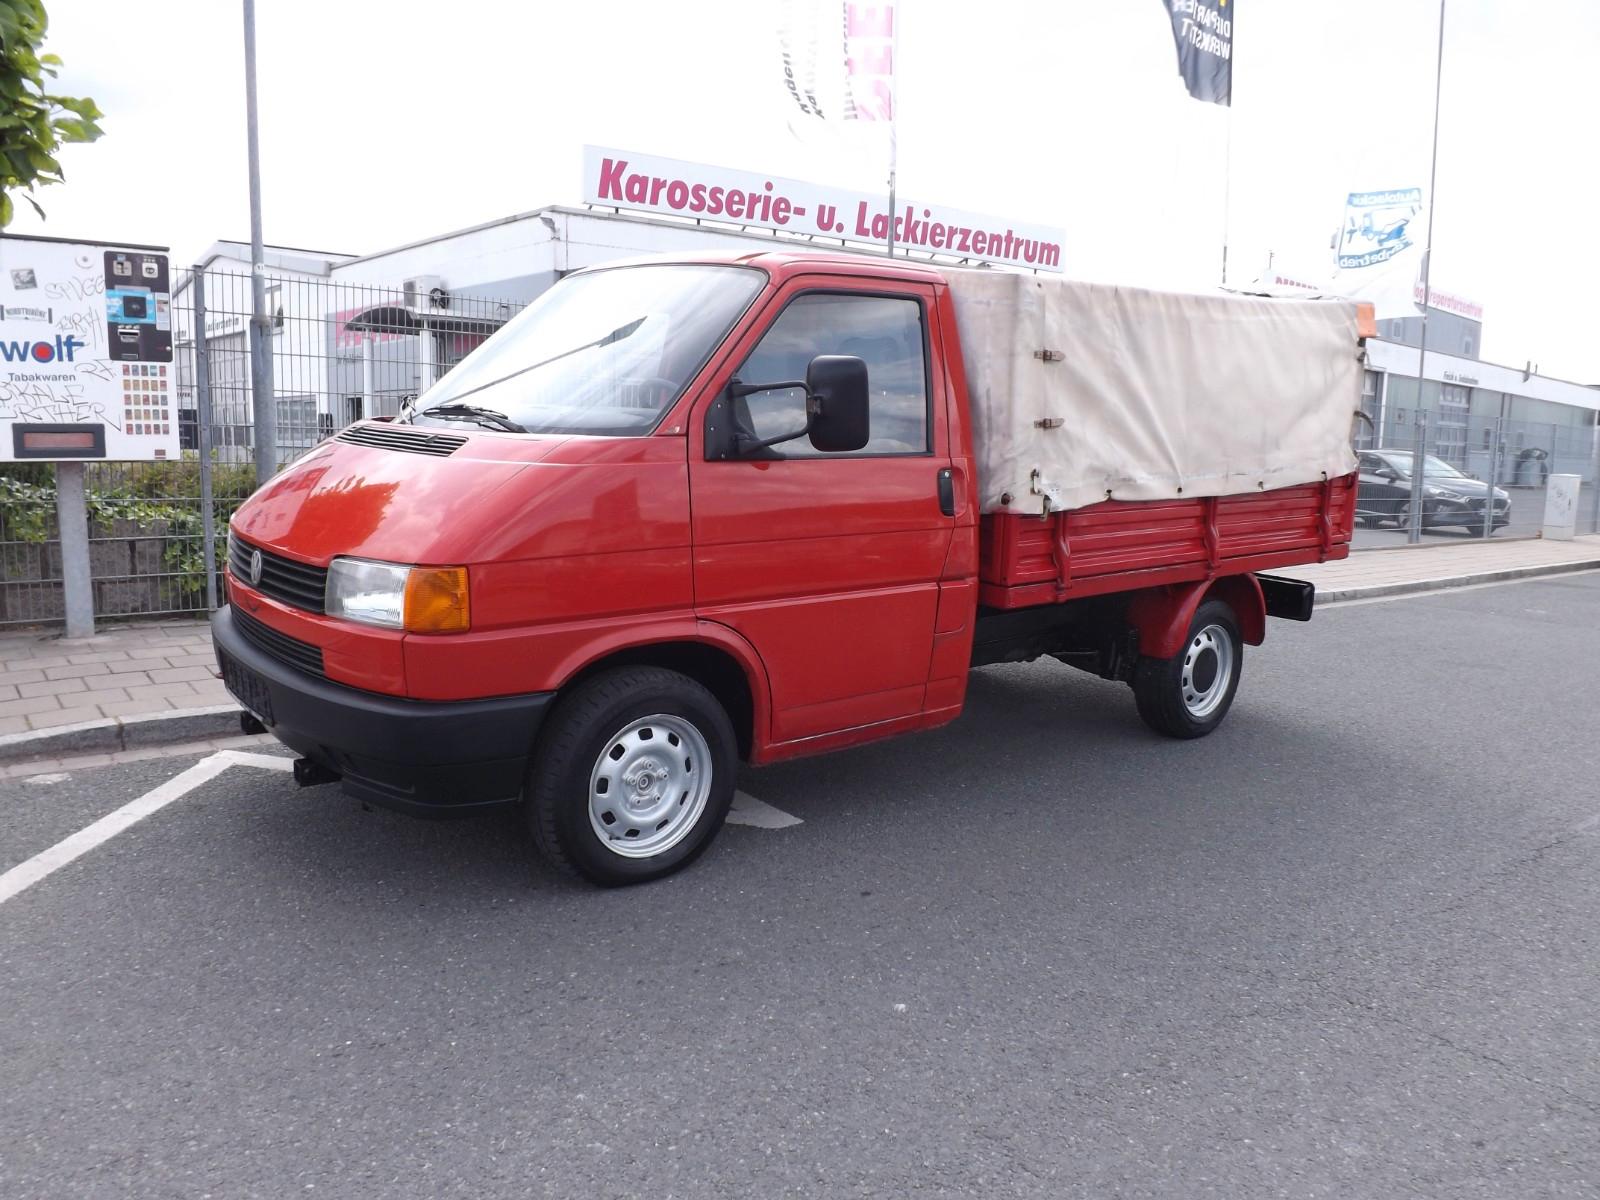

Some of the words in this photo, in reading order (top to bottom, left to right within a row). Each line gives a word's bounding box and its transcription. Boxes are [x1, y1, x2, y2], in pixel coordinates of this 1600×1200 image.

[598, 158, 806, 226] Karosserie-
[817, 204, 845, 233] u.
[855, 201, 1061, 267] Lackierzentrum
[0, 334, 85, 364] wolf
[8, 372, 76, 382] Tabakwaren
